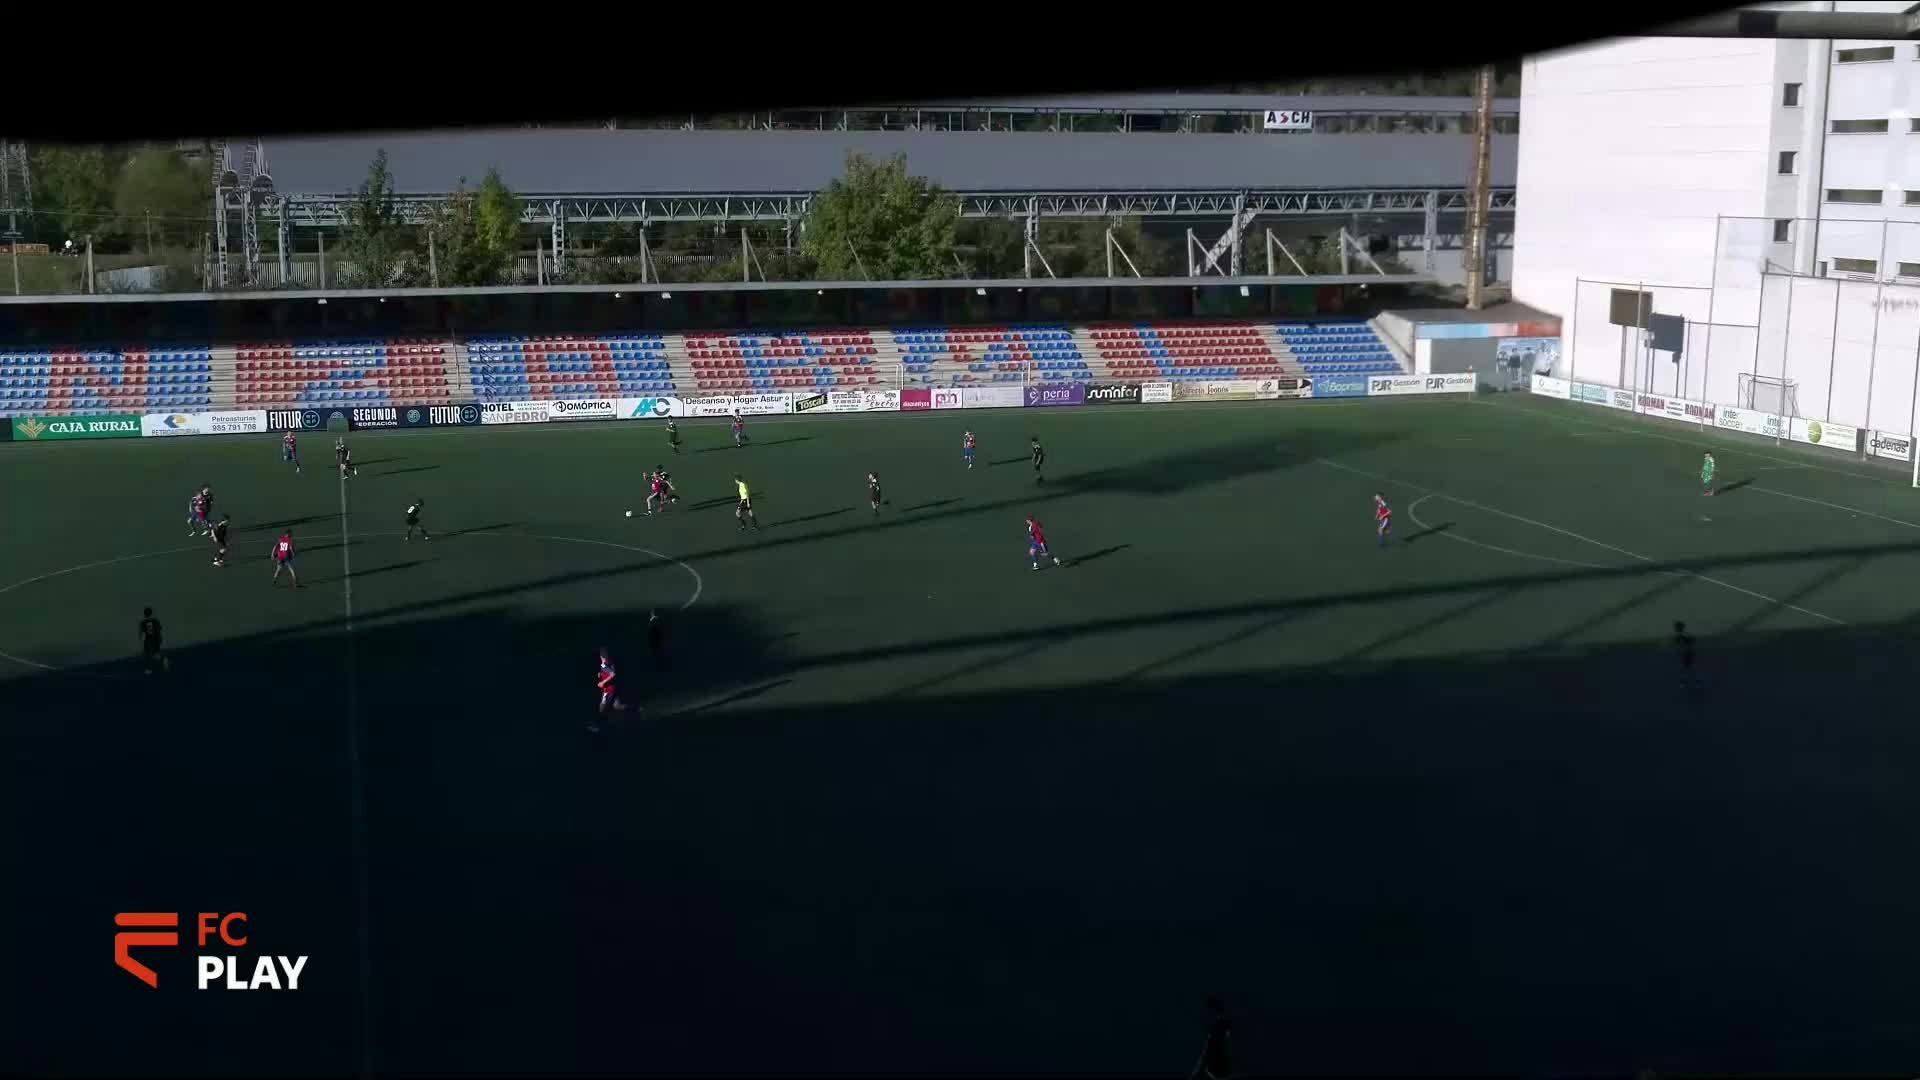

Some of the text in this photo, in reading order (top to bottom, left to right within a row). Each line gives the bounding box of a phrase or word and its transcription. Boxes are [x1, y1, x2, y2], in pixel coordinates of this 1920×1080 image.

[685, 397, 726, 405] Descanso
[734, 396, 758, 405] Hogar
[481, 403, 514, 412] HOTEL
[354, 408, 397, 421] SEGUNDA
[50, 420, 139, 433] CAJA RURAL
